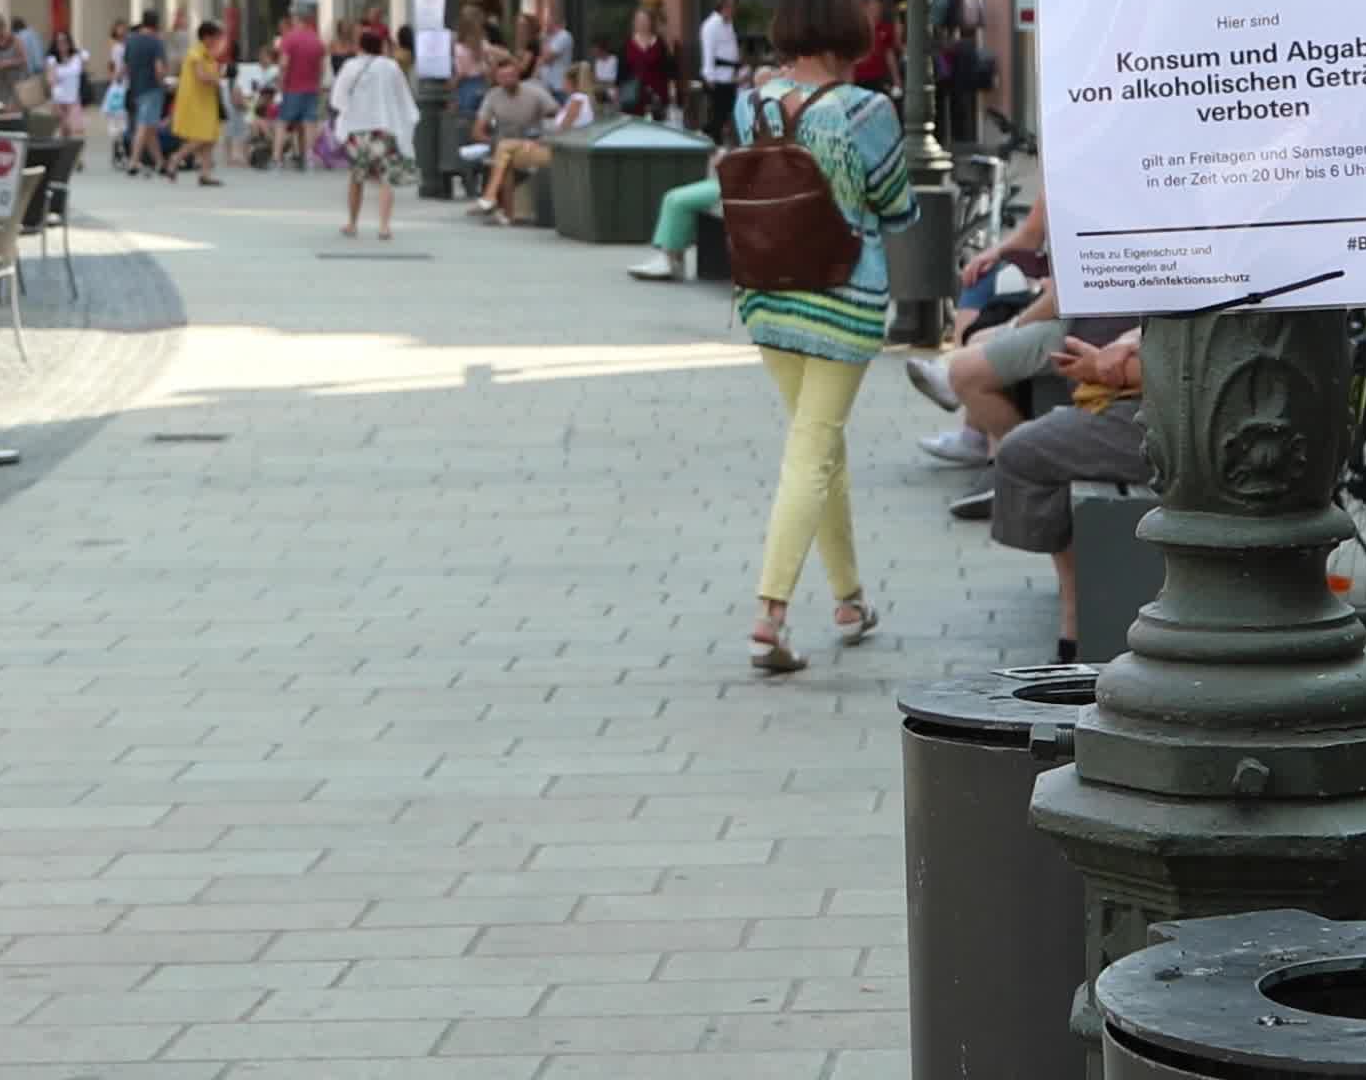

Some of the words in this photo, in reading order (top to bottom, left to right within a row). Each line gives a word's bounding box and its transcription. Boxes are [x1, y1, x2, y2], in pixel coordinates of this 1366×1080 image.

[1217, 16, 1245, 30] Hier
[1250, 14, 1280, 28] sind
[1116, 47, 1220, 72] Konsum
[1229, 43, 1278, 66] und
[1067, 86, 1112, 103] von
[1121, 71, 1297, 100] alkoholischen
[1197, 99, 1310, 123] verboten
[1141, 154, 1163, 170] gilt
[1168, 155, 1185, 166] an
[1189, 150, 1256, 167] Freitagen
[1260, 147, 1288, 161] und
[1146, 174, 1159, 188] in
[1164, 172, 1187, 187] der
[1190, 172, 1216, 186] Zeit
[1221, 172, 1248, 185] von
[1252, 168, 1270, 182] 20
[1274, 166, 1300, 181] Uhr
[1305, 164, 1326, 179] bis
[1330, 163, 1340, 178] 6
[1079, 249, 1105, 260] Infos
[1108, 250, 1121, 259] zu
[1123, 247, 1188, 259] Eigenschutz
[1191, 245, 1212, 255] und
[1081, 262, 1157, 275] Hygieneregeln
[1160, 260, 1177, 271] auf
